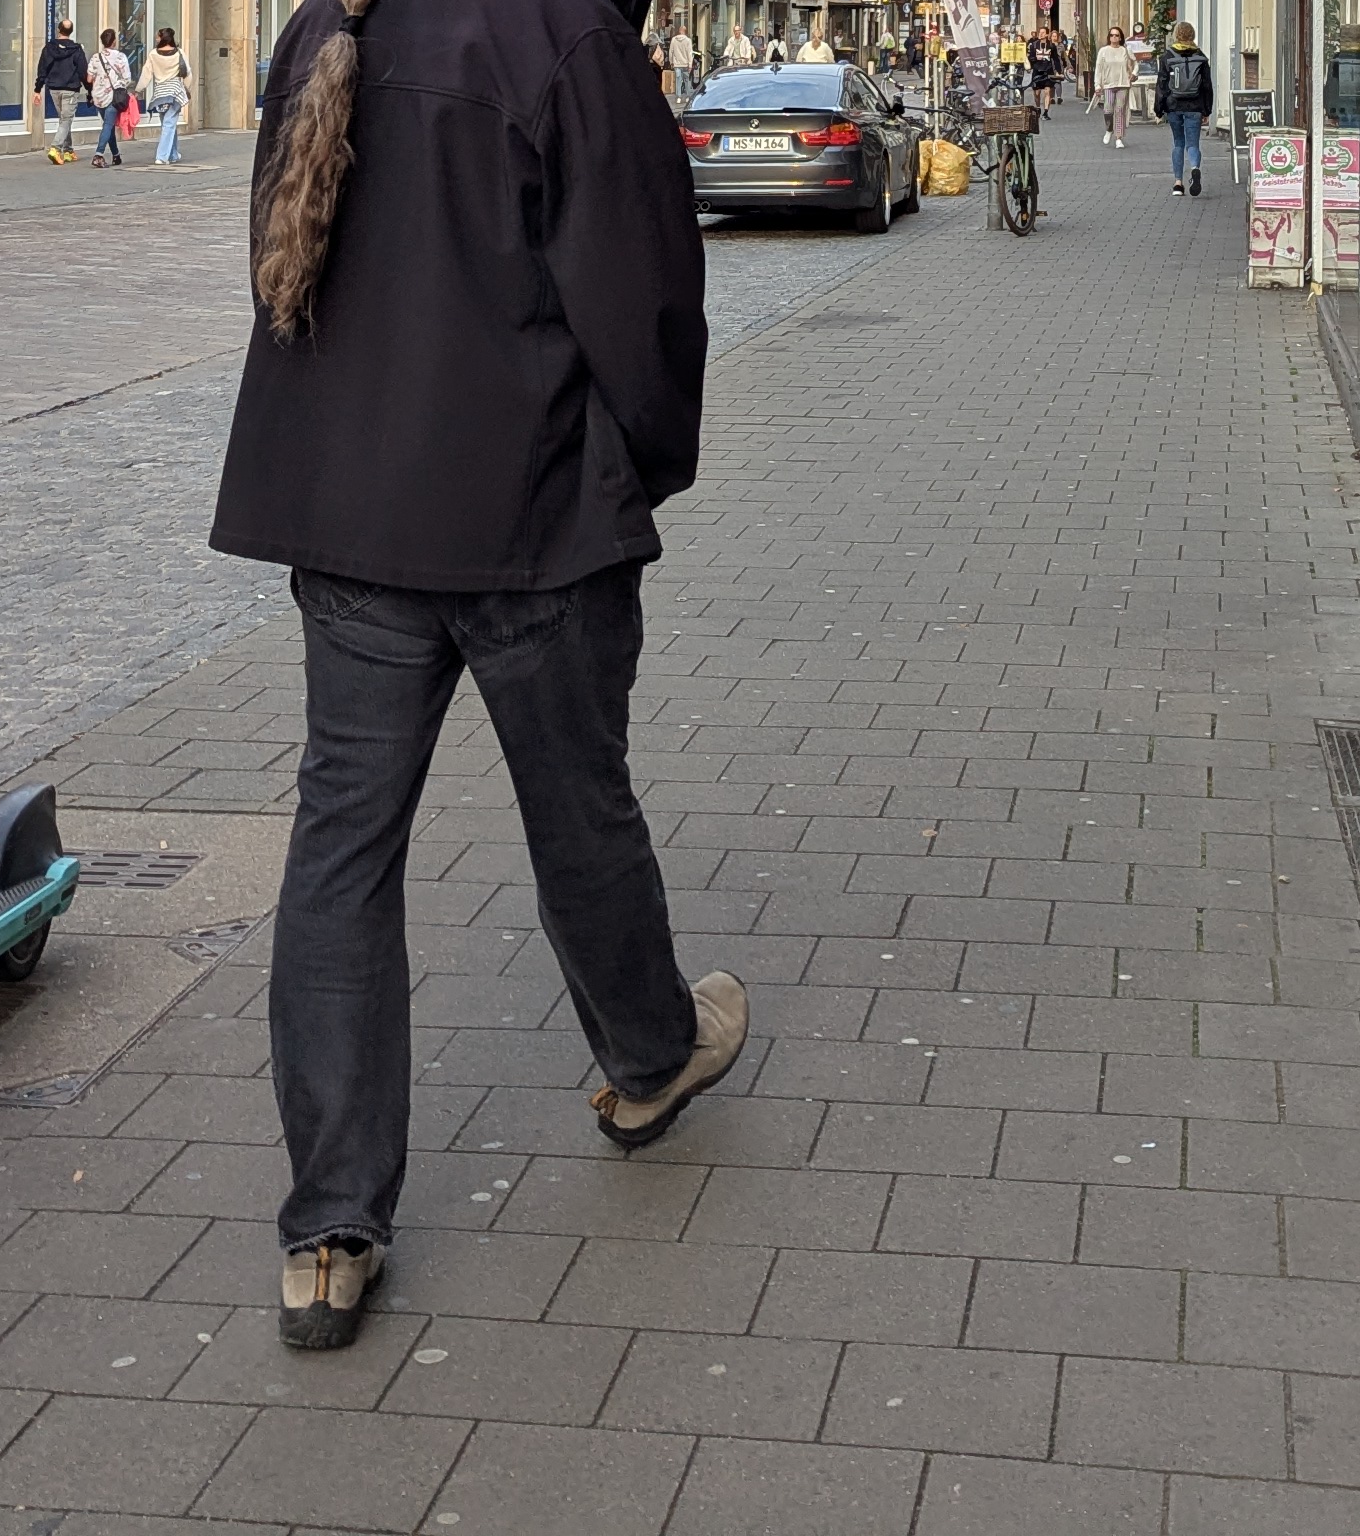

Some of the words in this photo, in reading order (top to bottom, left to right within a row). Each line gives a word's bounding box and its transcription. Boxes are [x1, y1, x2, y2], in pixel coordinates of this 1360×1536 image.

[1245, 110, 1265, 123] 20€
[734, 139, 747, 149] MS
[764, 138, 784, 149] 164
